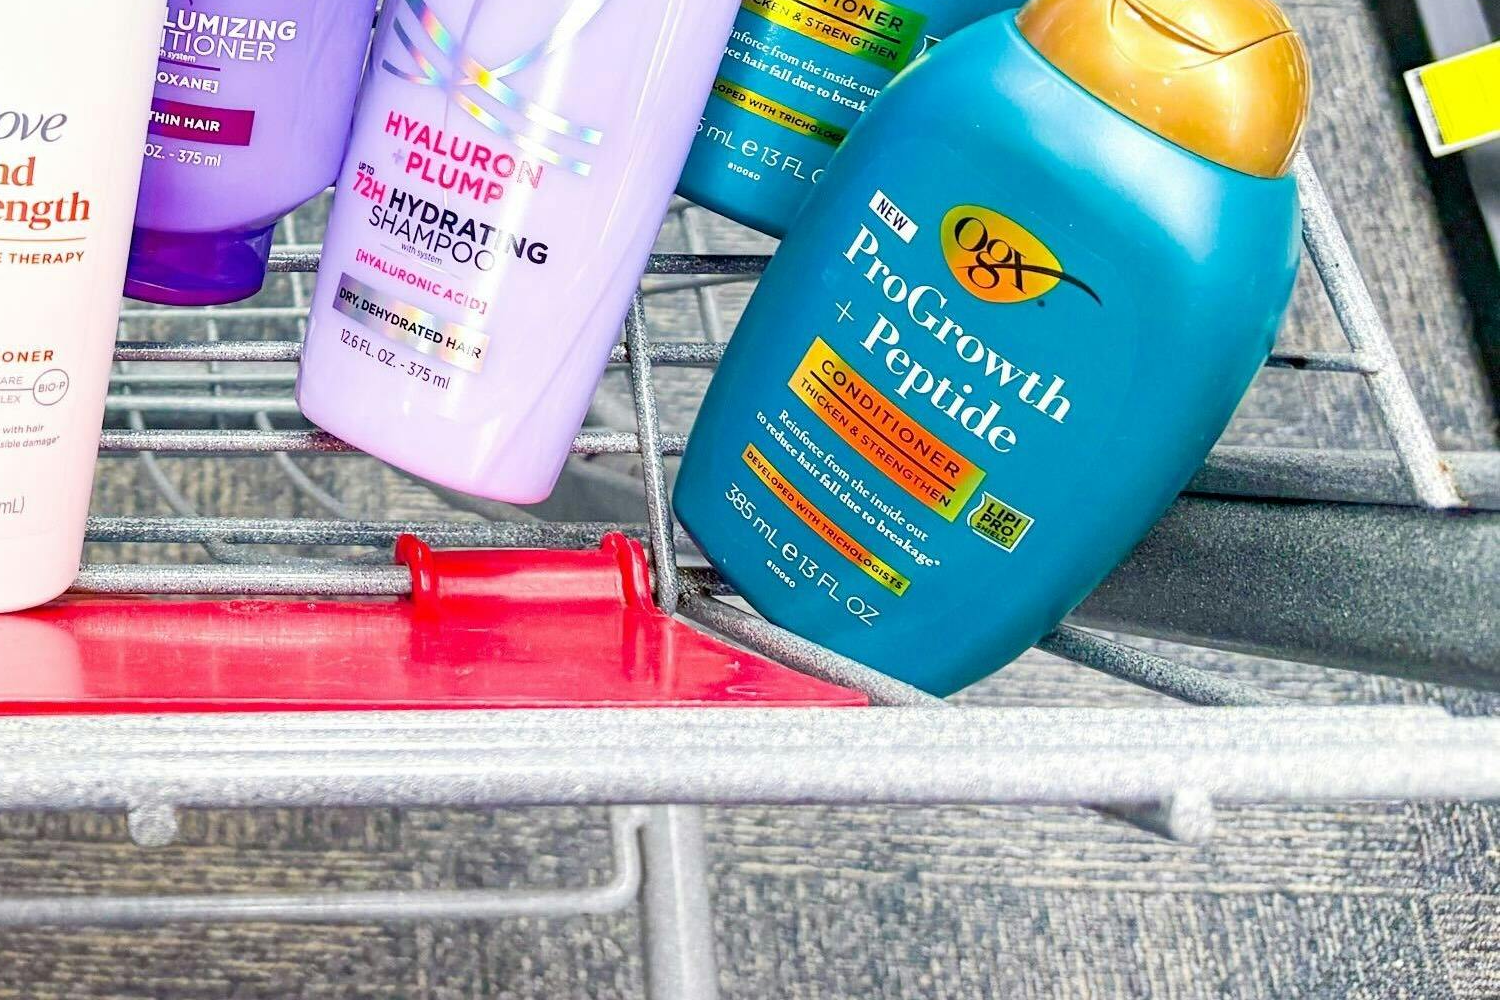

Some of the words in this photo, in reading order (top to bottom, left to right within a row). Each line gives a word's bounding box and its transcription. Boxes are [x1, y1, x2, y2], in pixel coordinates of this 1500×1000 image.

[160, 28, 277, 62] ITIONER
[163, 7, 297, 41] LUMIZING
[804, 16, 899, 61] STRENGTHEN
[167, 52, 197, 63] system
[741, 50, 768, 73] hair
[767, 63, 793, 83] fall
[791, 74, 815, 93] due
[770, 46, 800, 67] from
[801, 59, 821, 76] the
[822, 67, 858, 91] inside
[183, 116, 221, 132] HAIR
[749, 98, 777, 117] WITH
[177, 149, 203, 166] 375
[204, 154, 222, 168] ml
[385, 111, 544, 189] HYALURON
[706, 123, 737, 151] mL
[760, 146, 782, 168] 13
[781, 155, 806, 180] FL
[352, 172, 387, 204] 72H
[405, 151, 505, 205] PLUMP
[876, 198, 908, 232] NEW
[10, 250, 85, 265] THERAPY
[368, 204, 497, 272] SHAMPOO
[416, 247, 443, 266] system
[356, 248, 442, 297] [HYALURONIC
[443, 288, 488, 316] ACID]
[339, 286, 360, 309] DRY,
[361, 299, 444, 345] DEHYDRATED
[445, 336, 483, 360] HAIR
[842, 222, 1072, 425] ProGrowth
[340, 328, 359, 350] 12.6
[377, 348, 397, 369] OZ.
[407, 361, 432, 383] 375
[432, 371, 451, 390] ml
[38, 380, 67, 394] BIO-P
[859, 312, 1018, 454] Peptide
[2, 424, 24, 434] with
[25, 423, 45, 434] hair
[820, 358, 964, 479] CONDITIONER
[800, 376, 850, 428] THICKEN
[860, 434, 952, 508] STRENGTHEN
[765, 420, 799, 458] reduce
[796, 450, 821, 478] hair
[818, 471, 841, 498] fall
[839, 490, 863, 517] due
[778, 408, 826, 458] Reinforce
[823, 447, 852, 482] from
[850, 478, 871, 498] the
[869, 490, 906, 526] inside
[905, 521, 930, 543] out
[745, 450, 796, 503] DEVELOPED
[795, 498, 822, 526] WITH
[820, 521, 905, 591] TRICHOLOGISTS
[979, 512, 1014, 537] PRO
[986, 502, 1023, 529] LIPI
[724, 482, 754, 520] 385
[752, 515, 779, 549] mL
[798, 555, 820, 579] 13
[816, 572, 842, 602] FL
[846, 596, 881, 627] OZ
